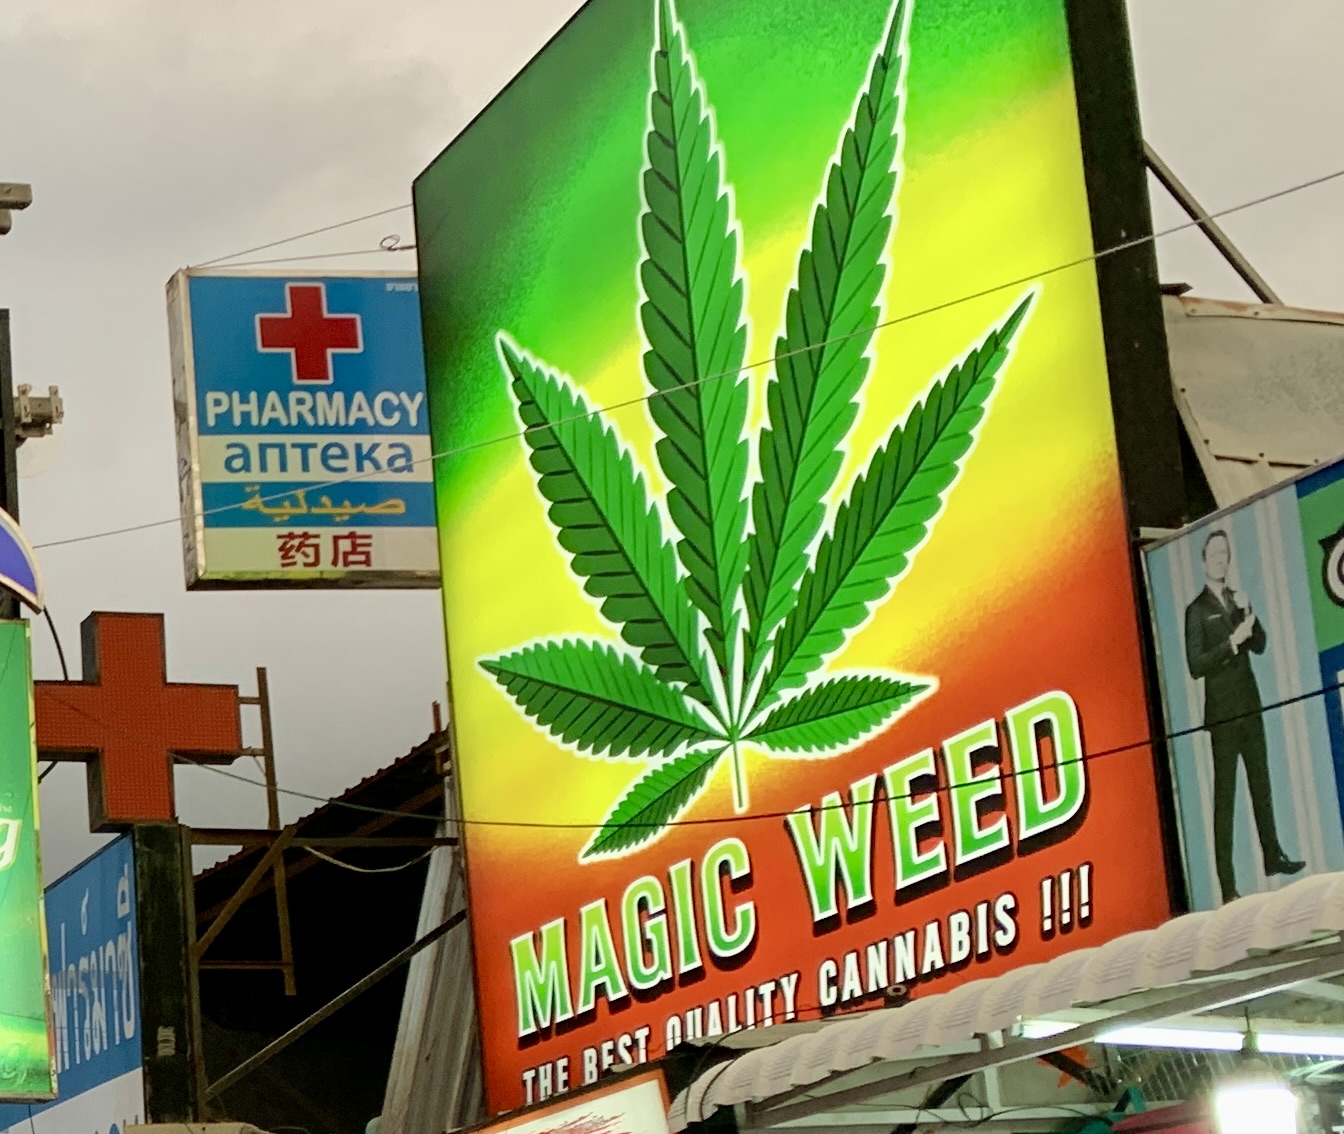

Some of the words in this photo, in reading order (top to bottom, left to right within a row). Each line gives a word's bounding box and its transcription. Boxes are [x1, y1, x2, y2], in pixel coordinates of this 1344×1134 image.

[205, 390, 424, 428] PHARMACY
[223, 441, 415, 474] аптека
[276, 530, 373, 569] 药店
[509, 836, 758, 1042] MAGIC
[784, 688, 1089, 930] WEED
[521, 1054, 569, 1106] THE
[581, 1024, 652, 1086] BEST
[664, 972, 800, 1052] QUALITY
[816, 890, 1019, 1009] CANNABIS
